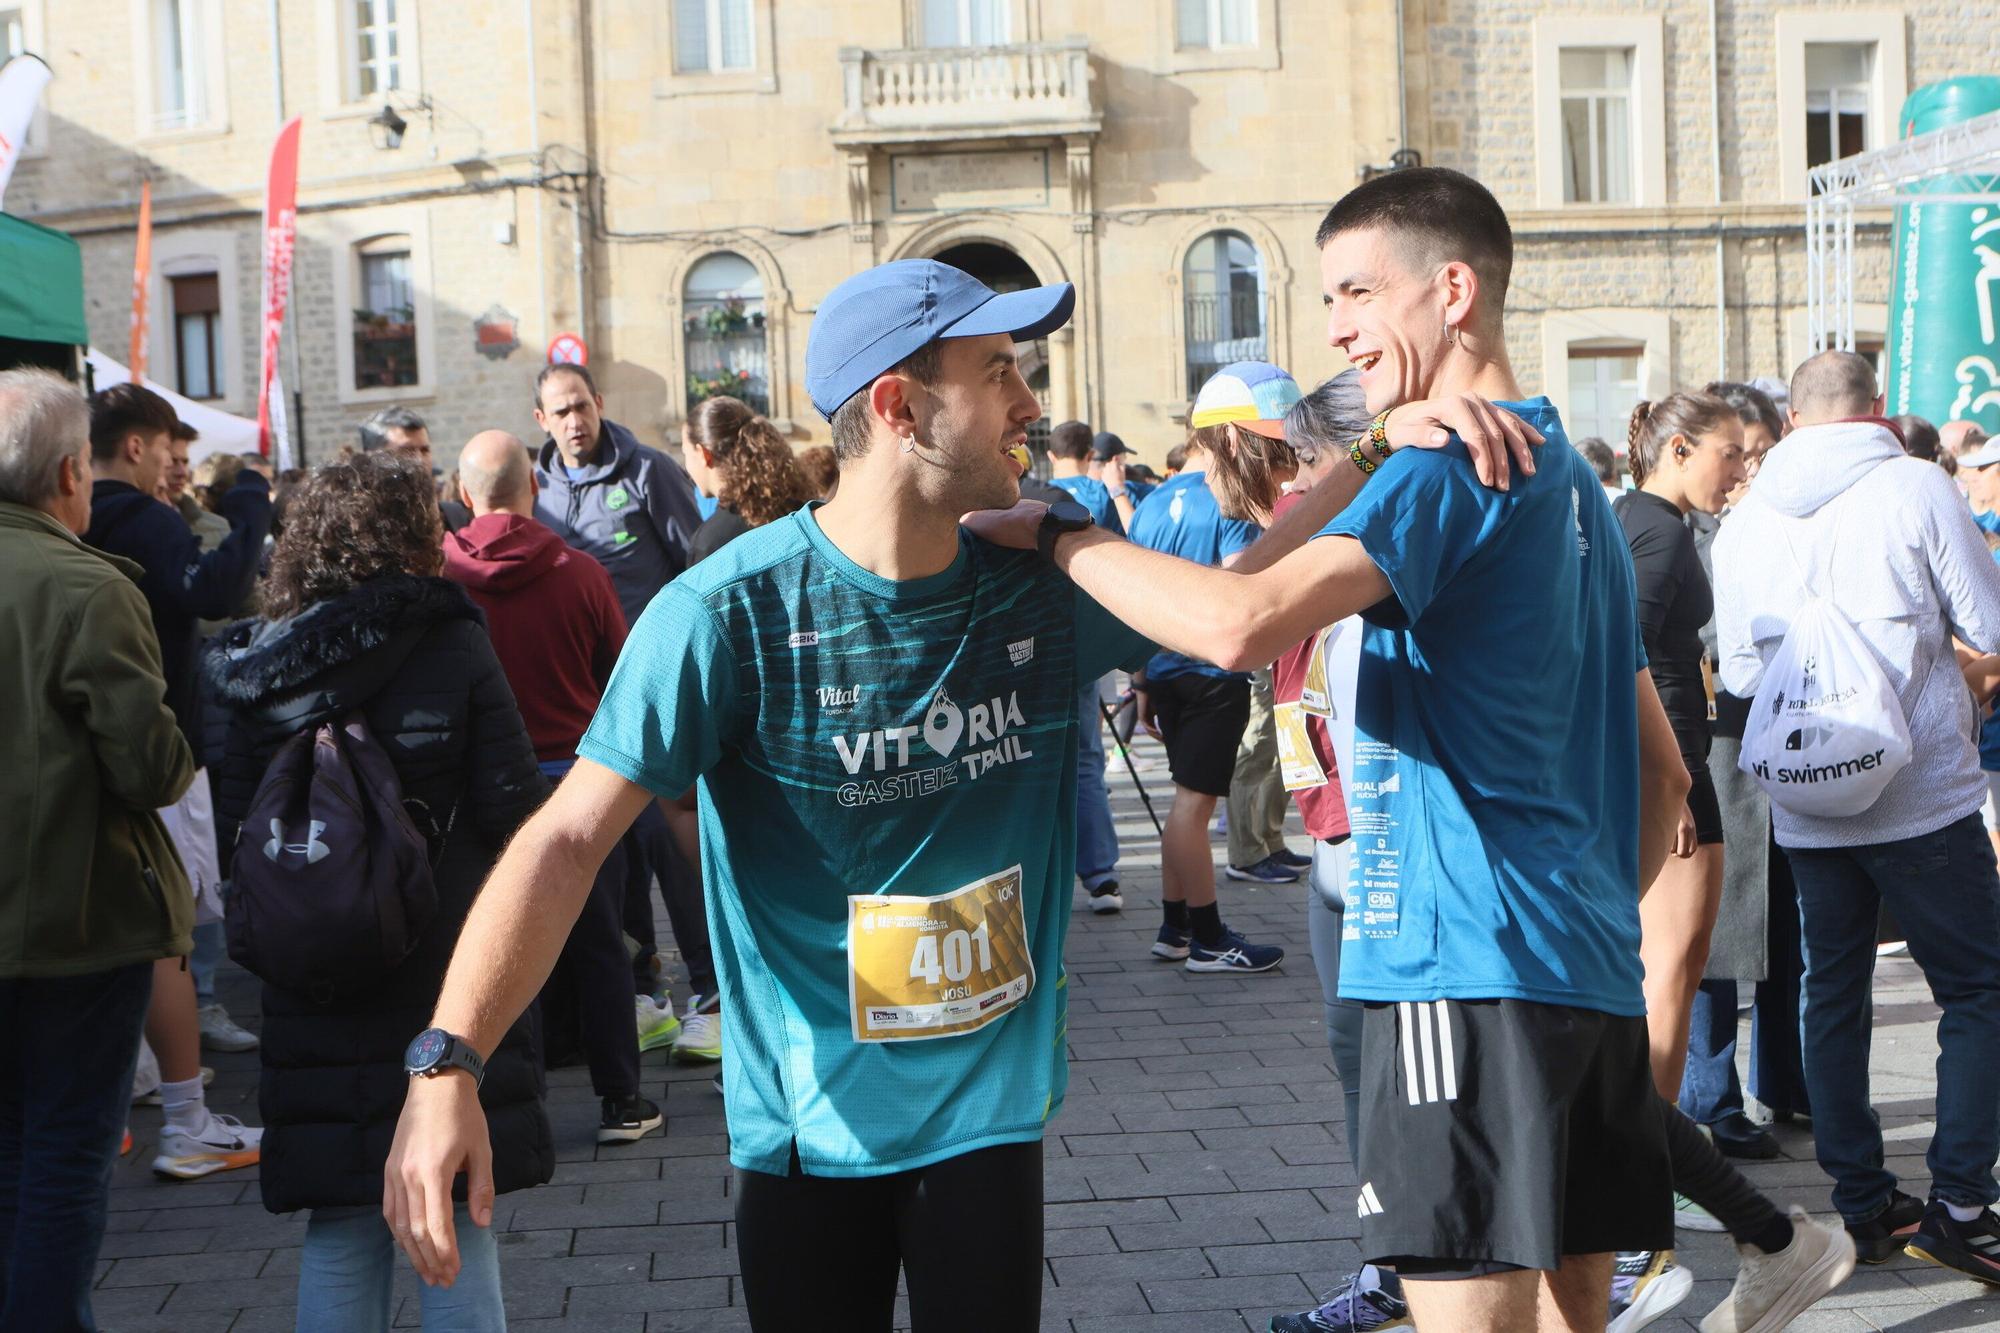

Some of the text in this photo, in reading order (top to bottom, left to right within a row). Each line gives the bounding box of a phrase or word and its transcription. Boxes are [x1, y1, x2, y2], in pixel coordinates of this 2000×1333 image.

[1898, 201, 1920, 416] www.vitoria-gasteiz.or
[816, 684, 860, 708] Vital
[832, 688, 1026, 775] VITORIA
[837, 735, 1033, 807] GASTEIZ TRAIL
[1777, 748, 1885, 784] swimmer
[998, 883, 1014, 903] 10K
[909, 920, 992, 985] 401
[941, 984, 972, 1001] JOSU
